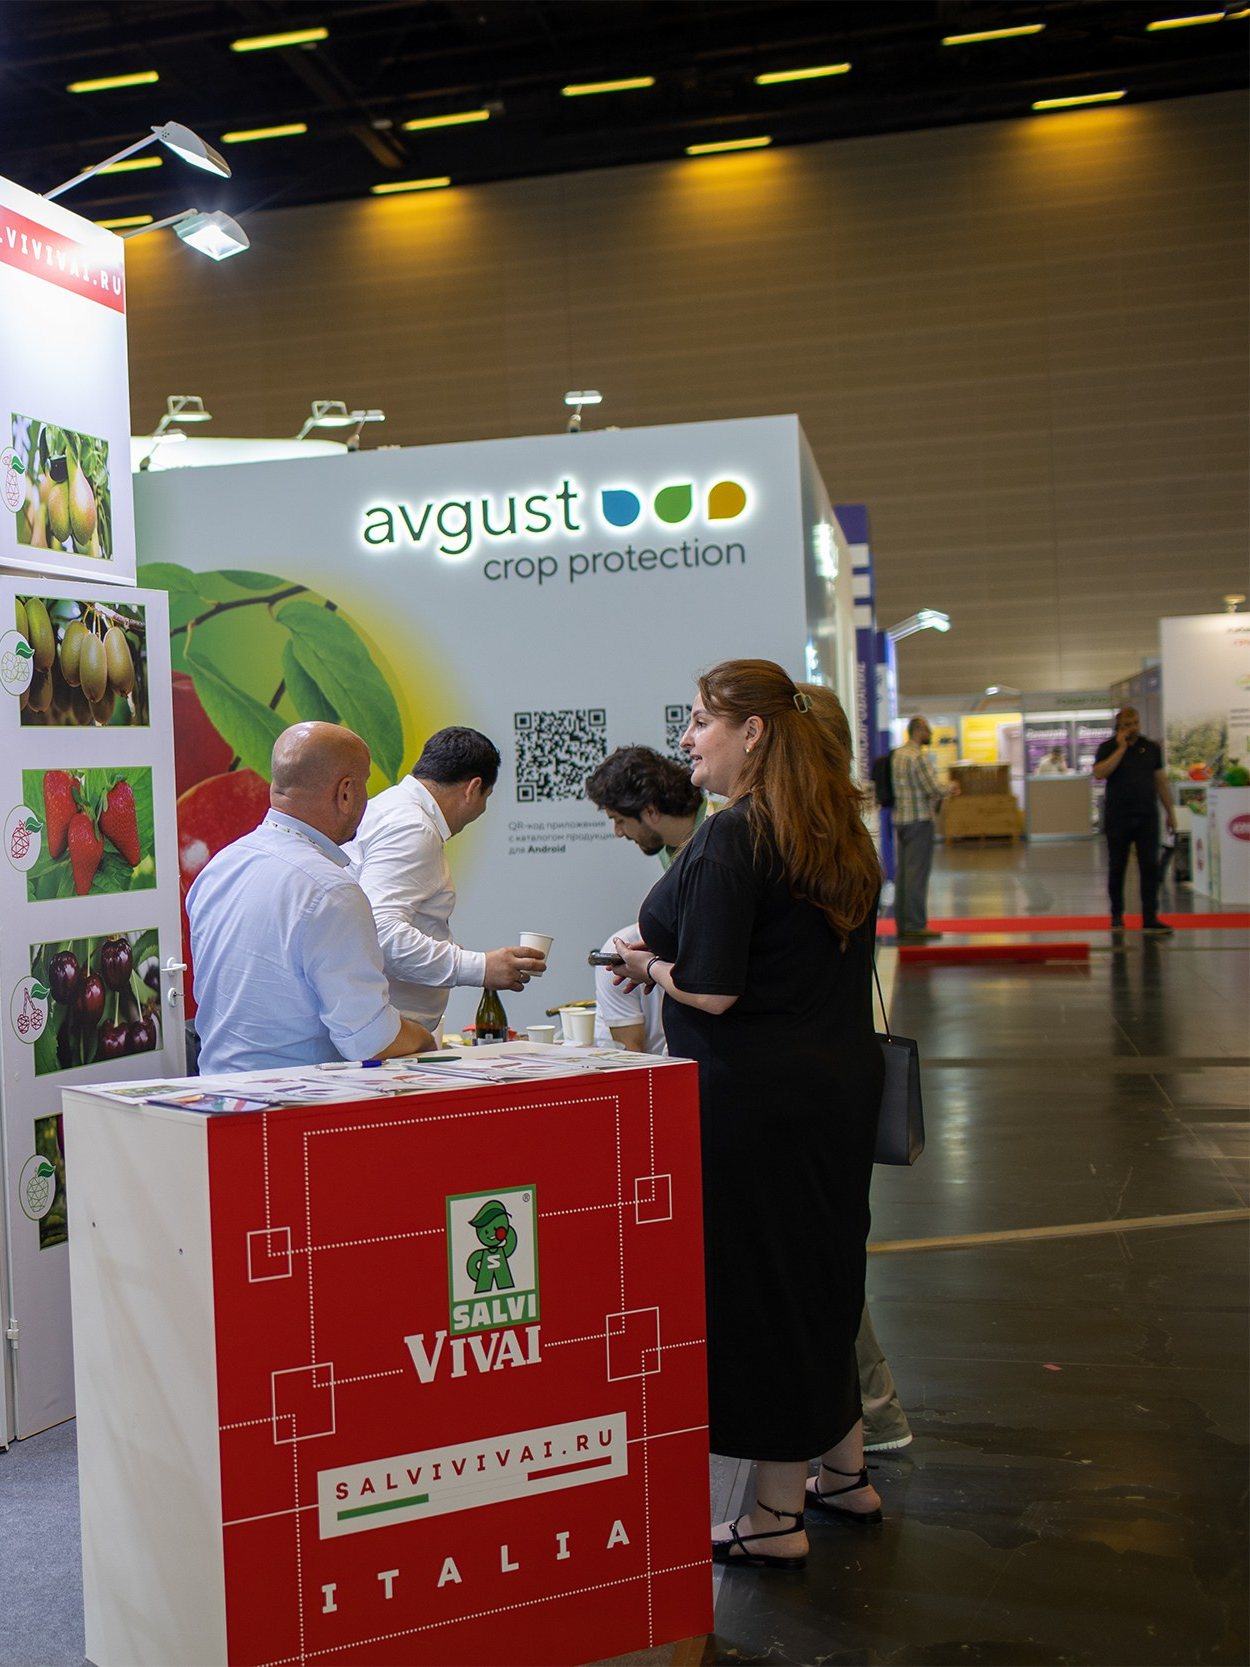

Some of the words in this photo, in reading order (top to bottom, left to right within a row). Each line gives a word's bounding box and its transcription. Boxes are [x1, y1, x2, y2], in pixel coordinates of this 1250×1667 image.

[363, 480, 580, 555] avgust
[483, 555, 558, 586] crop
[569, 537, 746, 584] protection
[508, 820, 545, 831] QR-код
[546, 820, 606, 830] приложения
[508, 846, 526, 855] для
[528, 844, 566, 853] Android
[516, 834, 564, 842] каталогом
[453, 1293, 537, 1331] SALVI
[404, 1325, 542, 1384] VIVAI
[335, 1428, 613, 1501] SALVIVIVAI.RU
[321, 1519, 631, 1614] ITALIA
